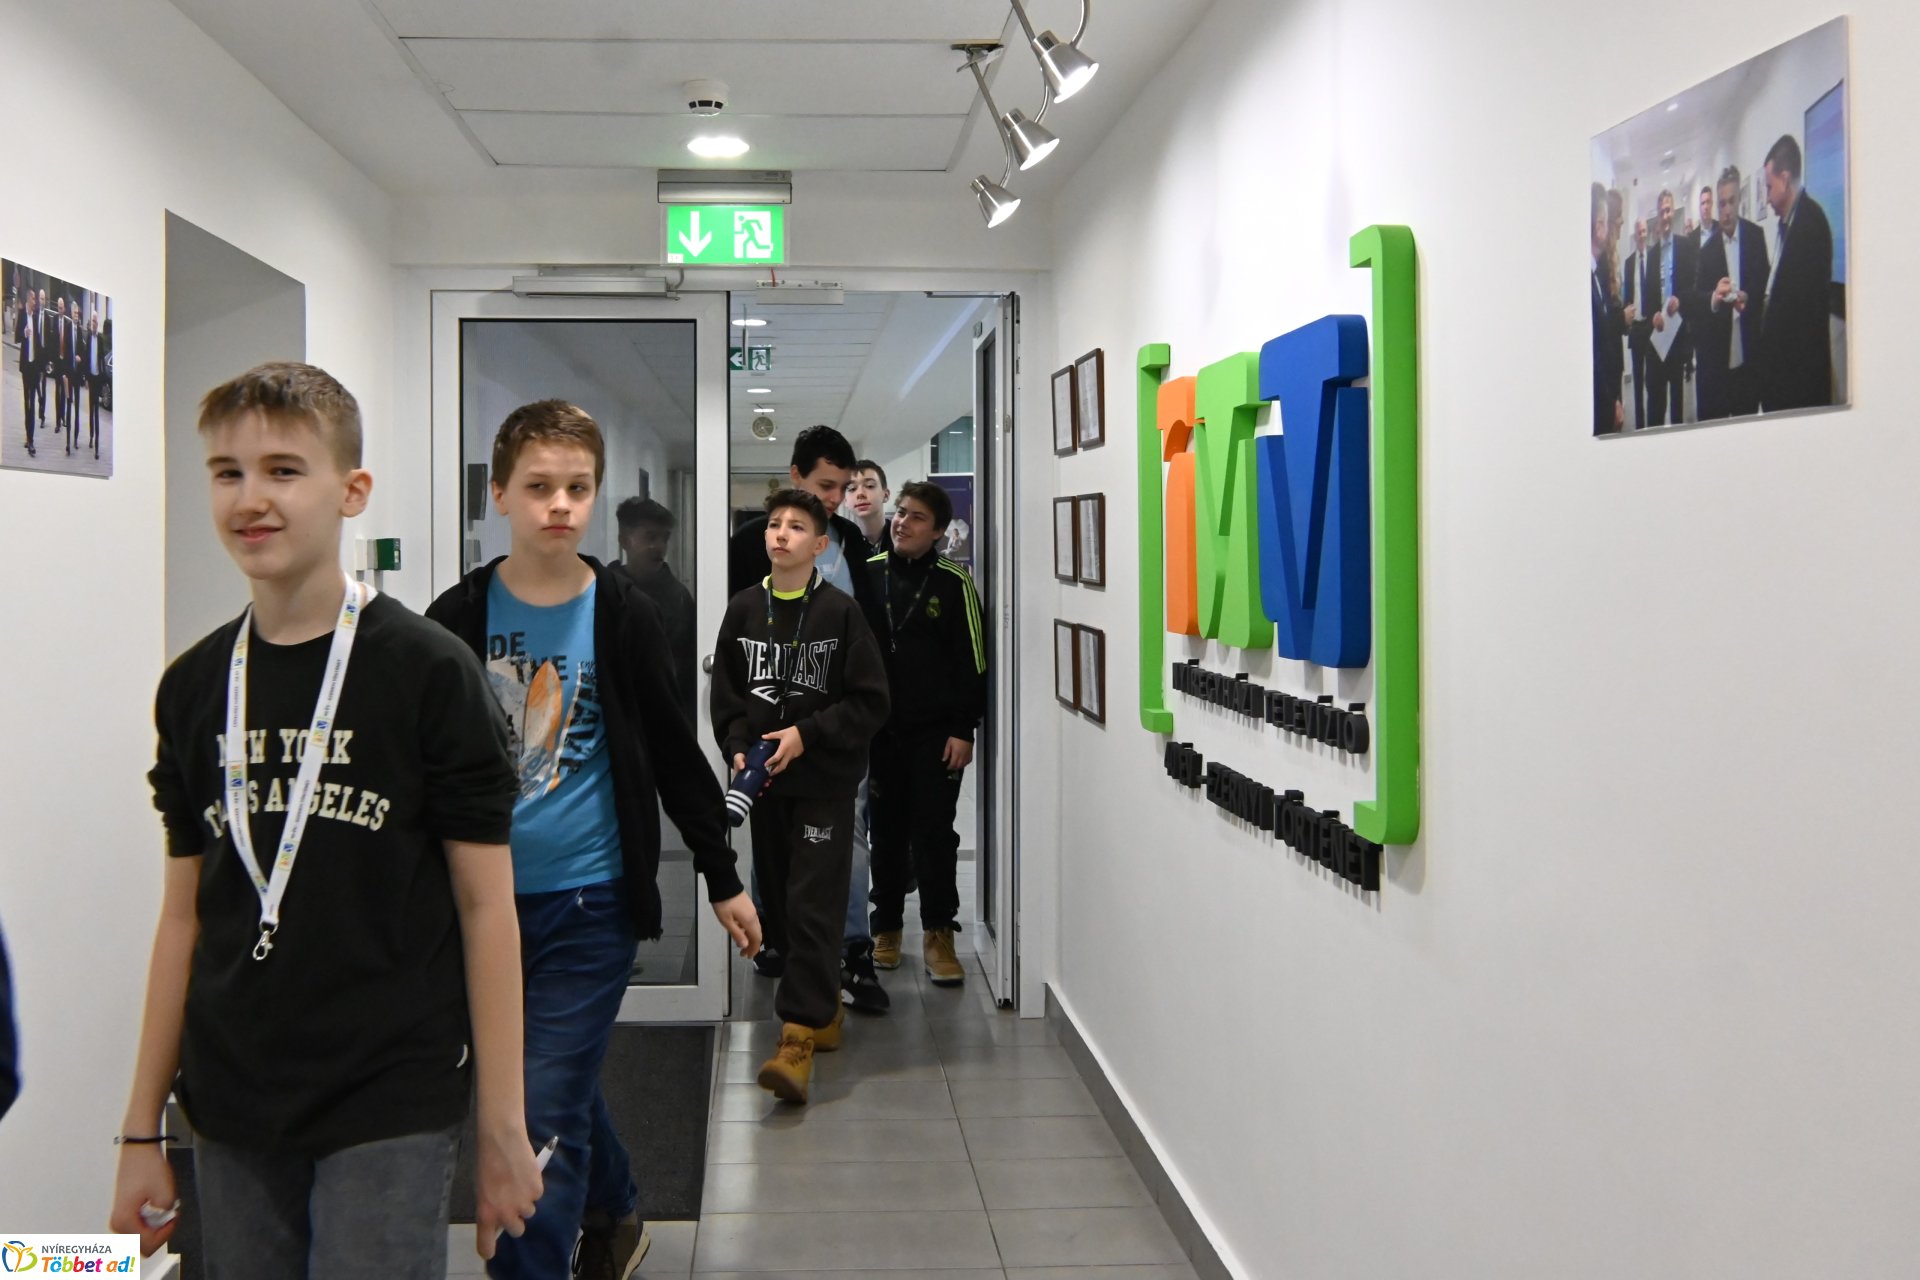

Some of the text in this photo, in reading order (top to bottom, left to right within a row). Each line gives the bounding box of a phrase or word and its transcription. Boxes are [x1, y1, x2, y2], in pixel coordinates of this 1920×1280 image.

[489, 631, 527, 662] DE
[216, 728, 353, 767] NW YOK
